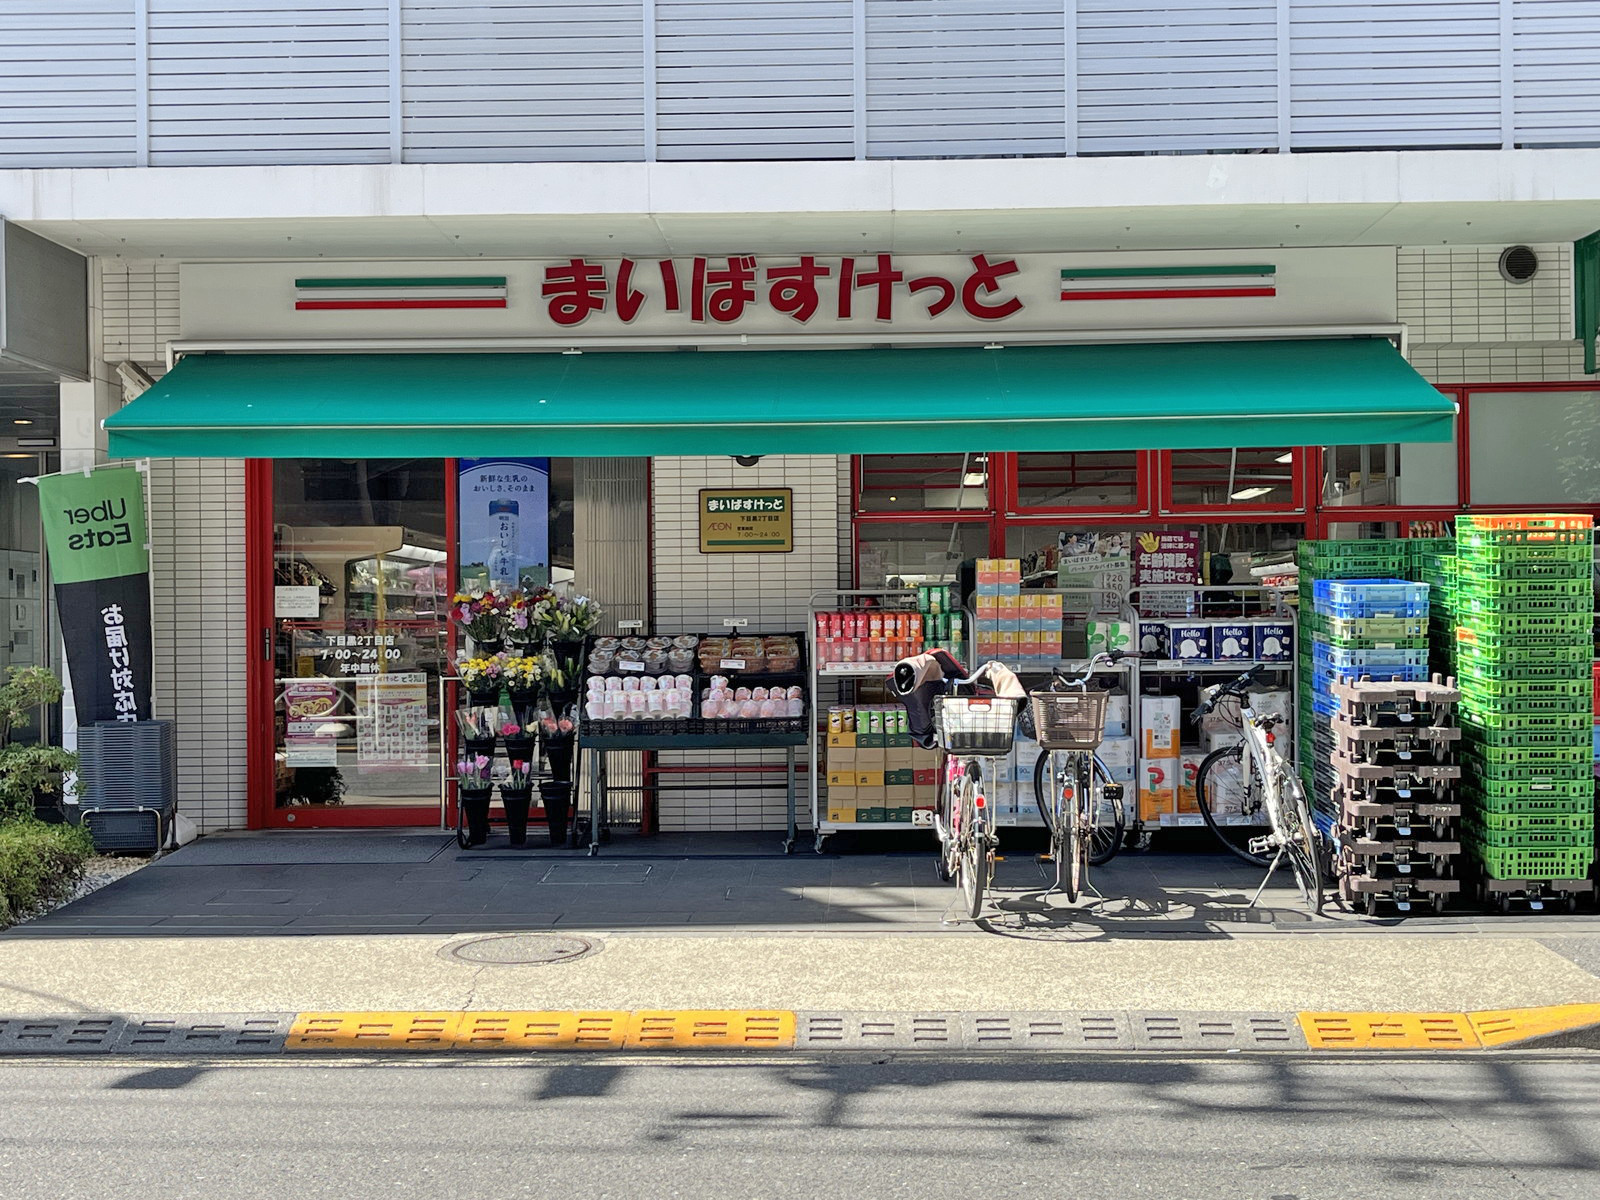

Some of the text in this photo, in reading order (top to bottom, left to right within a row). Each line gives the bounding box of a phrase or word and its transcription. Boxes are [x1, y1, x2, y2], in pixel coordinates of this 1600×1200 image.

[541, 253, 1024, 326] まいばすけっと
[480, 474, 528, 483] 新鮮な生乳の
[473, 484, 535, 493] おいしさ、そのまま
[707, 498, 784, 511] まいばすけっと
[1063, 555, 1099, 565] まいばすけっと
[1139, 553, 1195, 568] 年齢確認を
[1139, 569, 1196, 583] 実施中です。
[1142, 624, 1161, 634] Hello
[1181, 629, 1200, 638] Hello
[1222, 627, 1243, 636] Hello
[1263, 627, 1284, 636] Hello
[325, 635, 395, 646] 下目黒2丁目店
[340, 662, 381, 673] 年中無休
